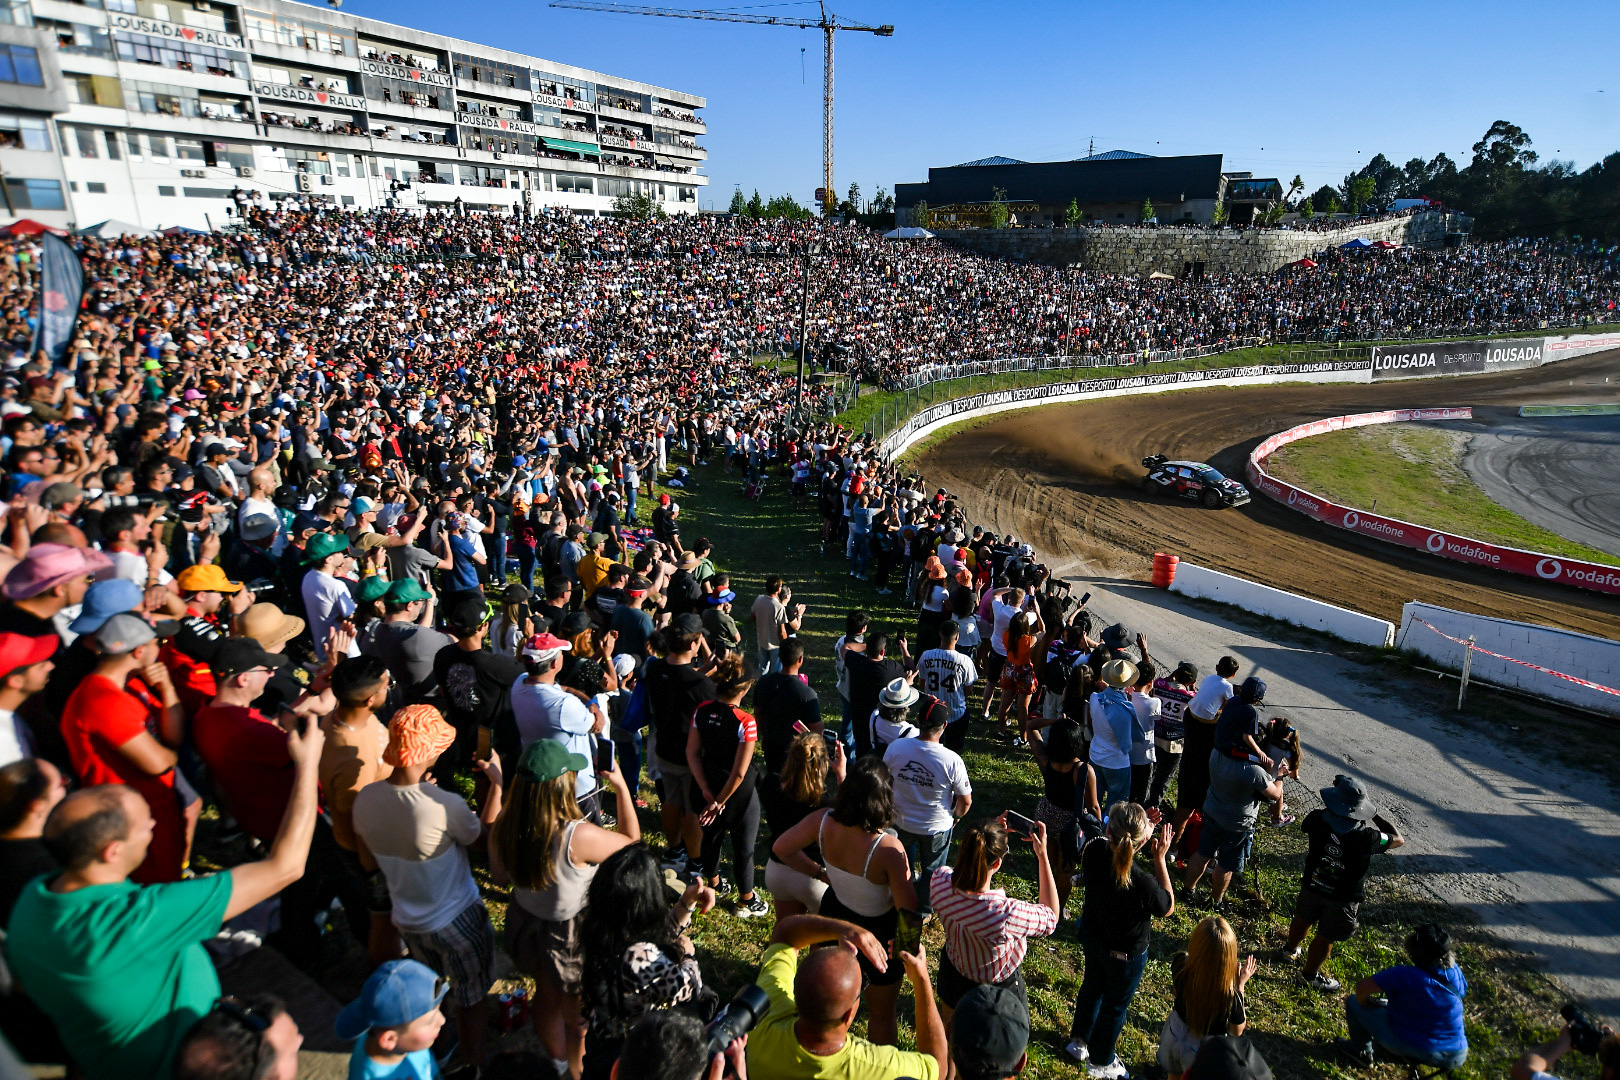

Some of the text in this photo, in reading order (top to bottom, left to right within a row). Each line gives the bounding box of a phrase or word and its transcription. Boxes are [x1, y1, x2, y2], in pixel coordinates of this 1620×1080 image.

[110, 15, 241, 48] LOUSADA RALLY
[362, 62, 451, 86] LOUSADA RALLY
[329, 96, 365, 108] RALLY
[533, 94, 595, 112] LOUSADA RALLY
[509, 124, 534, 133] RALLY
[636, 141, 656, 151] RALLY
[1375, 352, 1436, 370] LOUSADA
[1443, 352, 1481, 364] DESPORTO
[1486, 346, 1541, 363] LOUSADA
[930, 403, 953, 422] LOUSADA
[953, 396, 982, 413] DESPORTO
[983, 390, 1013, 406] LOUSADA
[1013, 386, 1047, 401] DESPORTO
[1048, 383, 1080, 396] LOUSADA
[1080, 381, 1115, 393] DESPORTO
[1116, 377, 1146, 389] LOUSADA
[1146, 374, 1177, 386] DESPORTO
[1177, 371, 1205, 382] LOUSADA
[1205, 369, 1235, 380] DESPORTO
[1235, 366, 1263, 377] LOUSADA
[1264, 364, 1298, 375] DESPORTO
[1299, 362, 1333, 373] LOUSADA
[1334, 361, 1370, 371] DESPORTO
[1297, 496, 1320, 512] vodafone
[1360, 518, 1404, 538] vodafone
[1447, 542, 1501, 563] vodafone
[924, 658, 962, 673] DETROIT
[928, 671, 956, 693] 34
[897, 773, 934, 787] Portugal
